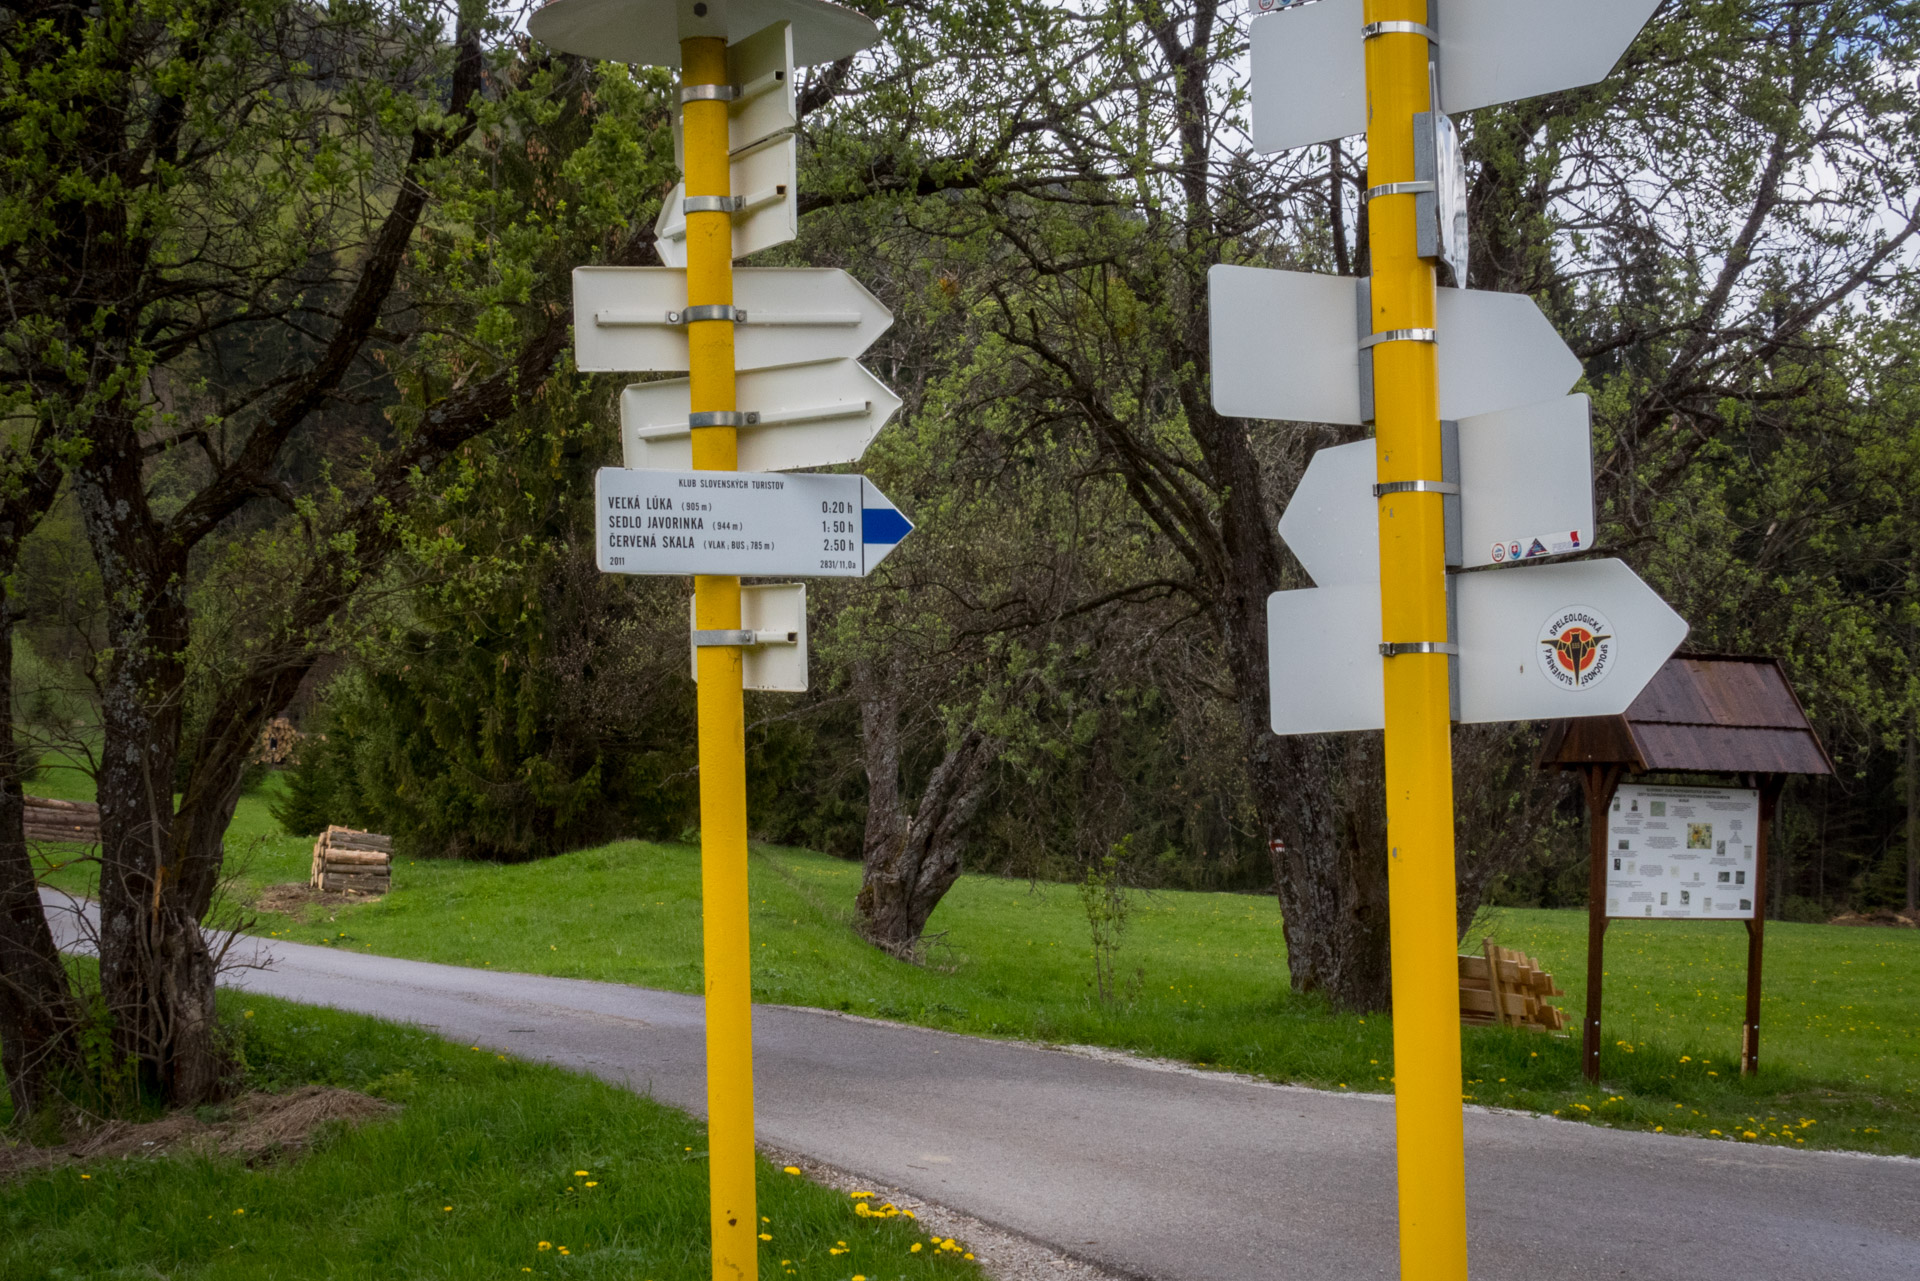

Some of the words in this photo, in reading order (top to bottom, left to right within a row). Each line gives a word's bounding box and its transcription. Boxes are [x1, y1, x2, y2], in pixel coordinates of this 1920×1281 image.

[679, 479, 697, 488] KLUB
[700, 479, 749, 489] SLOVENSKÝCH
[752, 480, 784, 490] TURISTOV
[608, 495, 641, 510] VEĽKÁ
[646, 495, 673, 511] LÚKA
[822, 501, 845, 514] 0:20
[847, 501, 853, 514] h
[609, 515, 642, 528] SEDLO
[647, 516, 704, 530] JAVORINKA
[848, 521, 854, 533] h
[609, 533, 657, 548] ČERVENÁ
[662, 536, 695, 549] SKALA
[824, 538, 846, 551] 2:50
[848, 539, 854, 551] h
[610, 557, 625, 566] 2011
[1549, 613, 1604, 636] SPELEOLOGICKÁ
[1543, 648, 1573, 685] SLOVENSKÁ
[1581, 644, 1608, 687] SPOLOČNOSŤ
